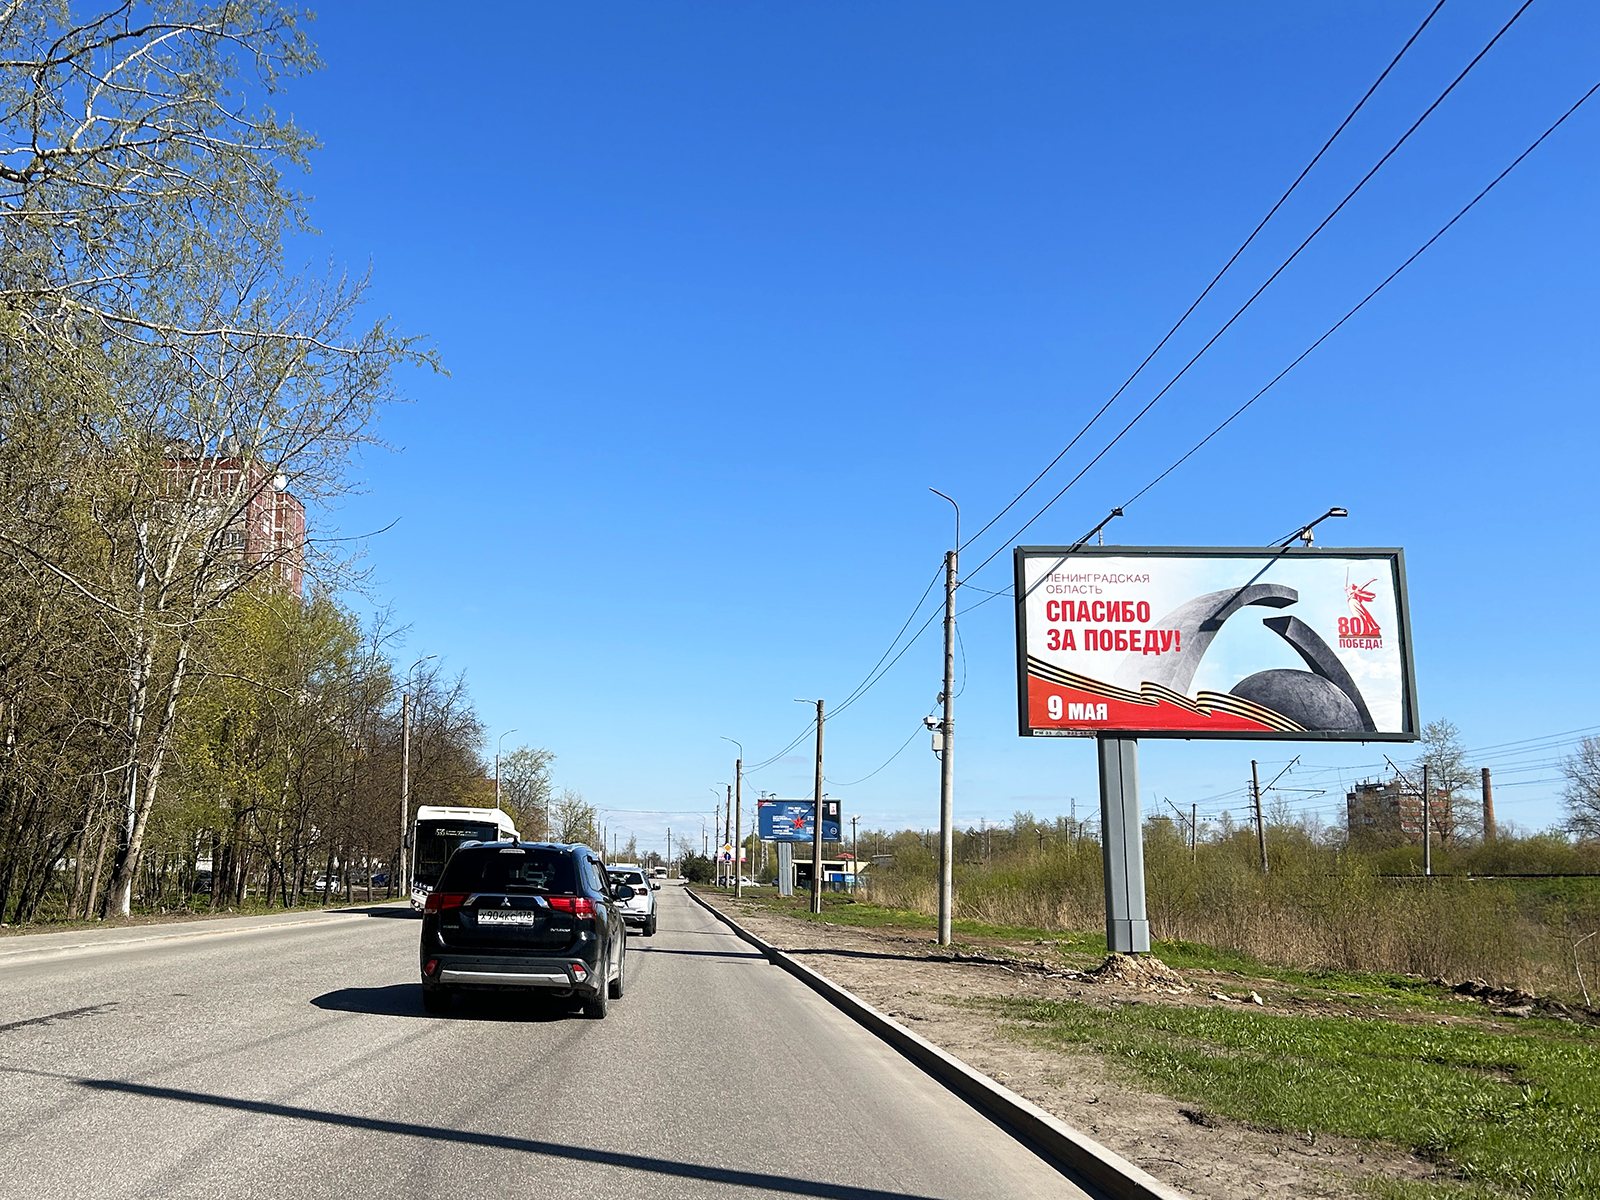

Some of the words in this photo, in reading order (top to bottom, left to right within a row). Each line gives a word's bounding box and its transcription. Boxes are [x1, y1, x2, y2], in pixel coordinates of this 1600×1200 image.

[1046, 573, 1150, 583] ЛЕНИНГРАДСКАЯ
[1046, 585, 1103, 594] ОБЛАСТЬ
[1046, 600, 1150, 622] СПАСИБО
[1338, 616, 1361, 636] 80
[1047, 629, 1077, 651] ЗА
[1084, 629, 1181, 655] ПОБЕДУ!
[1339, 639, 1382, 650] ПОБЕДА!
[1047, 695, 1063, 720] 9
[1068, 703, 1108, 720] МАЯ
